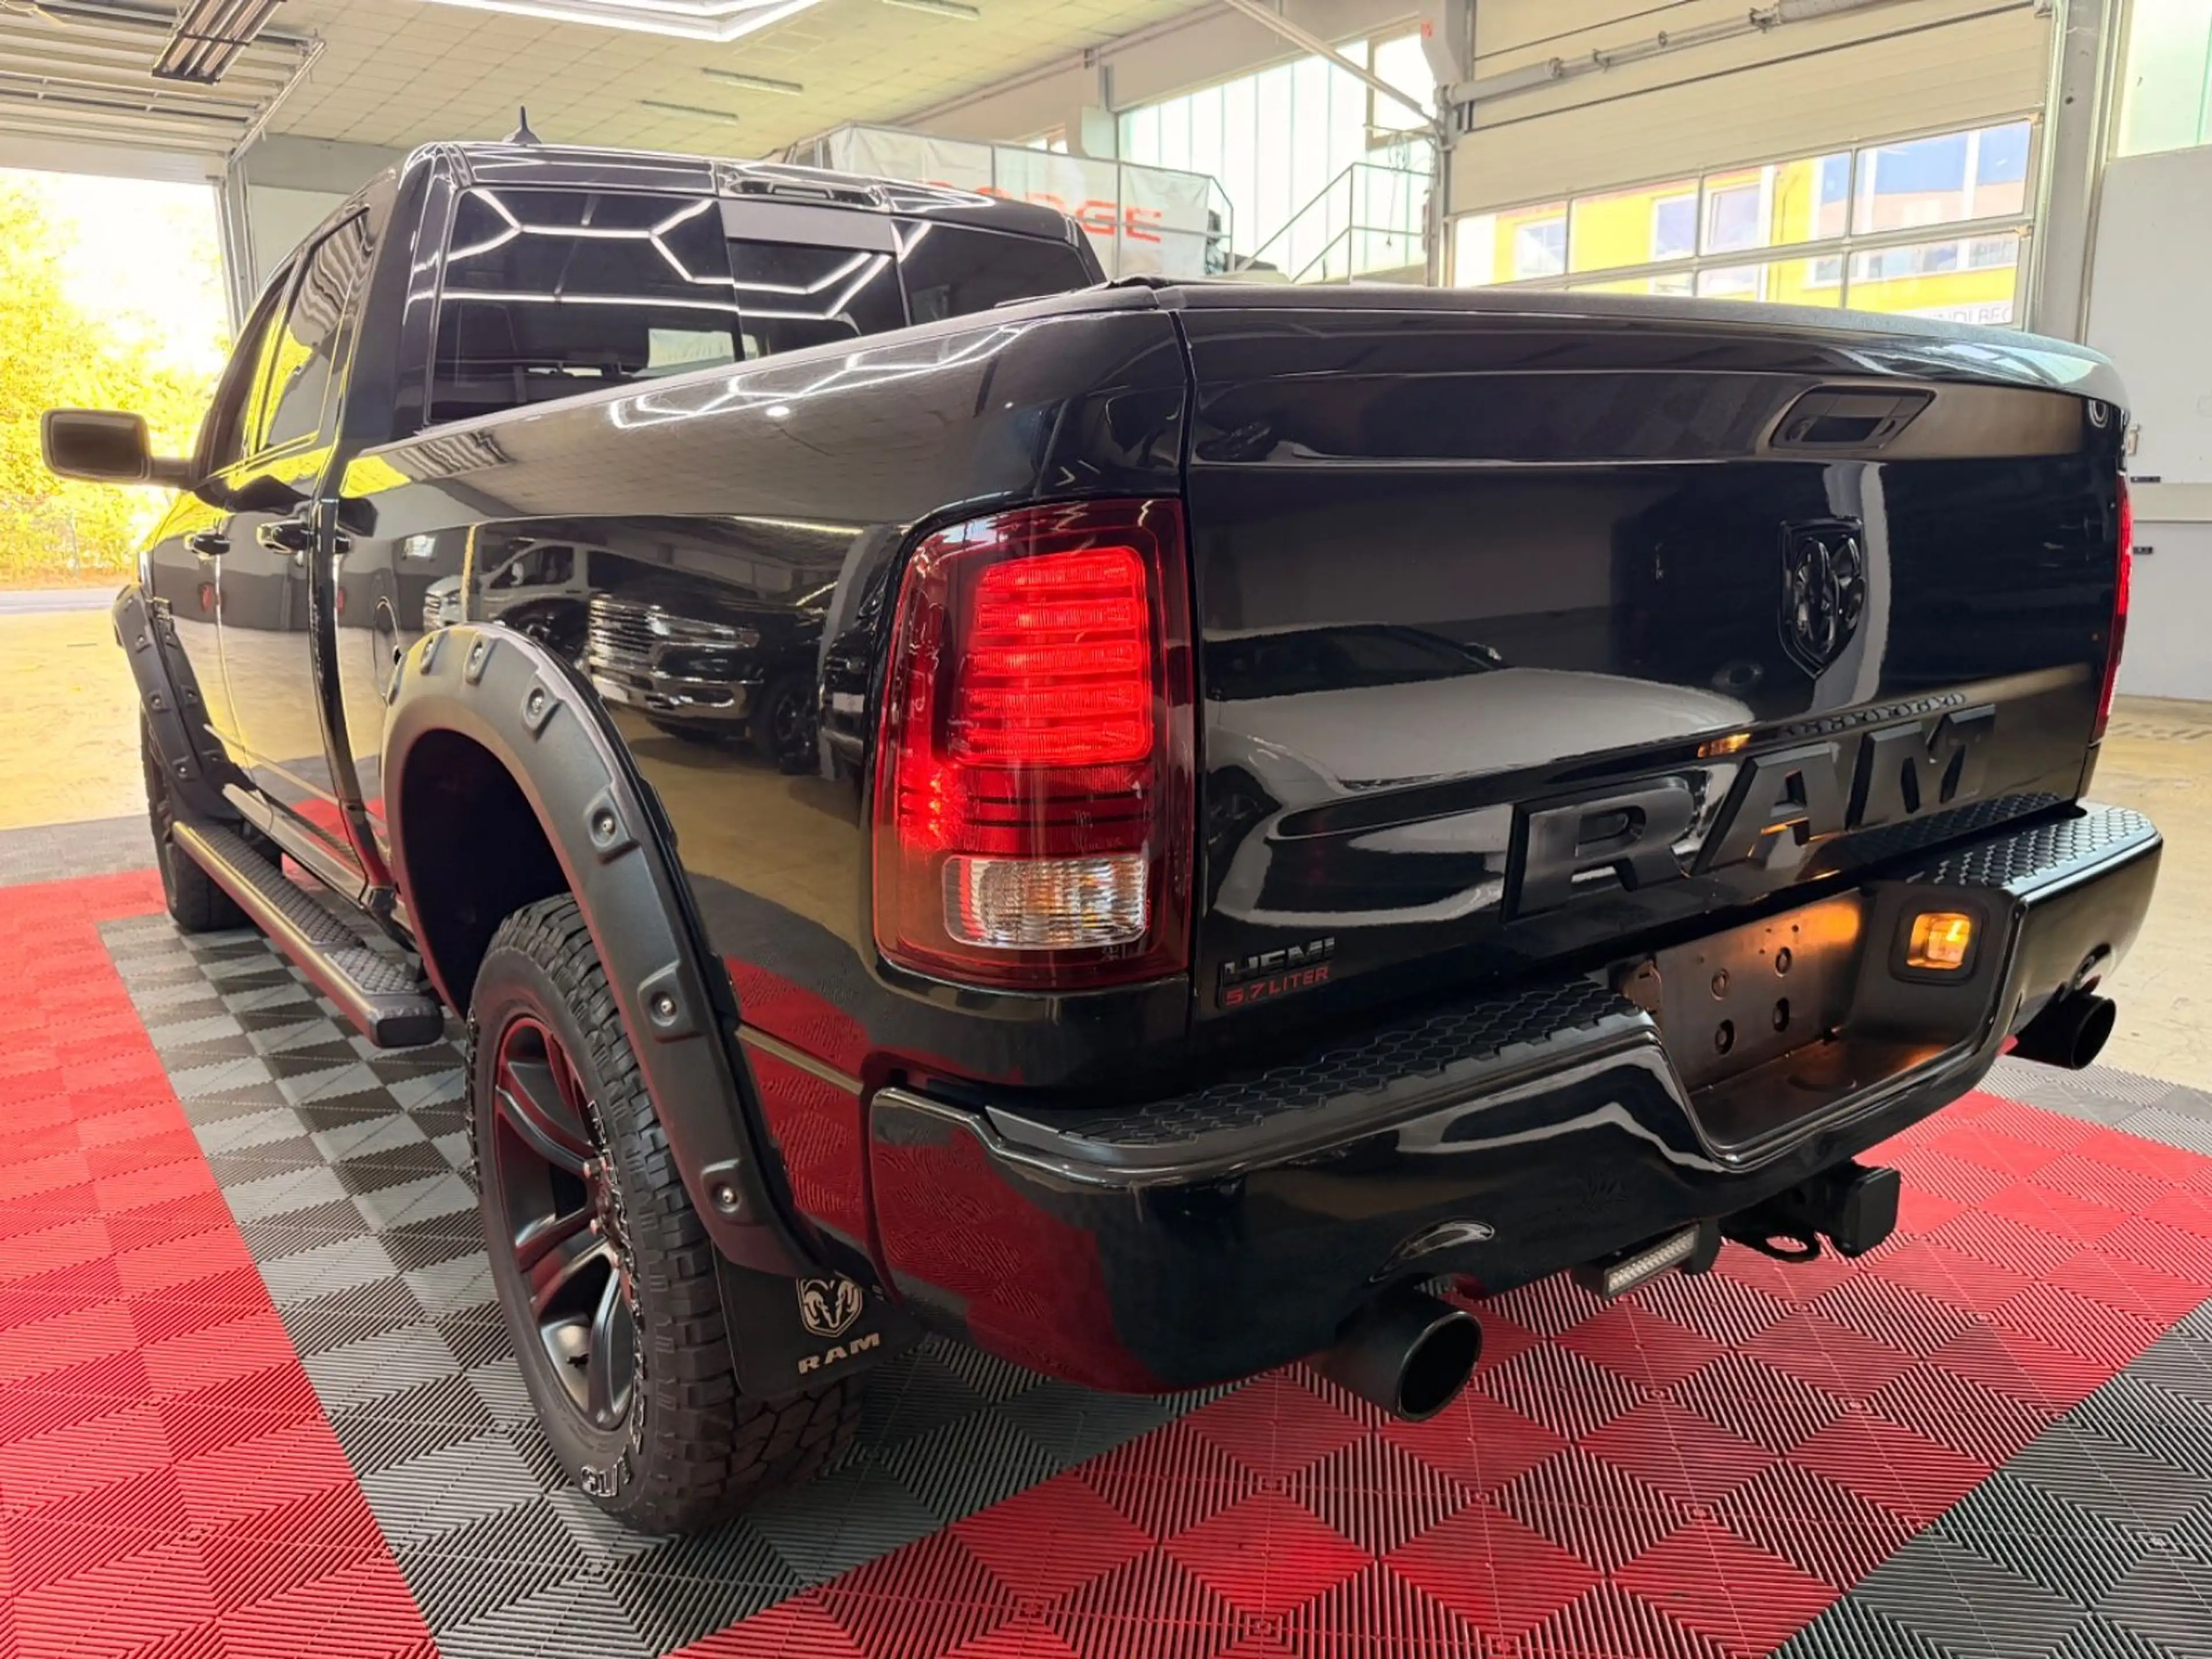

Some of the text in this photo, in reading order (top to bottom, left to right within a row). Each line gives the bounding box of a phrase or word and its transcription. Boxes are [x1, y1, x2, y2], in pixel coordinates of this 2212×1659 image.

[1501, 704, 1998, 922] RAM
[1222, 937, 1336, 983] HEMI
[1268, 967, 1329, 995] LITER
[798, 1332, 880, 1374] RAM
